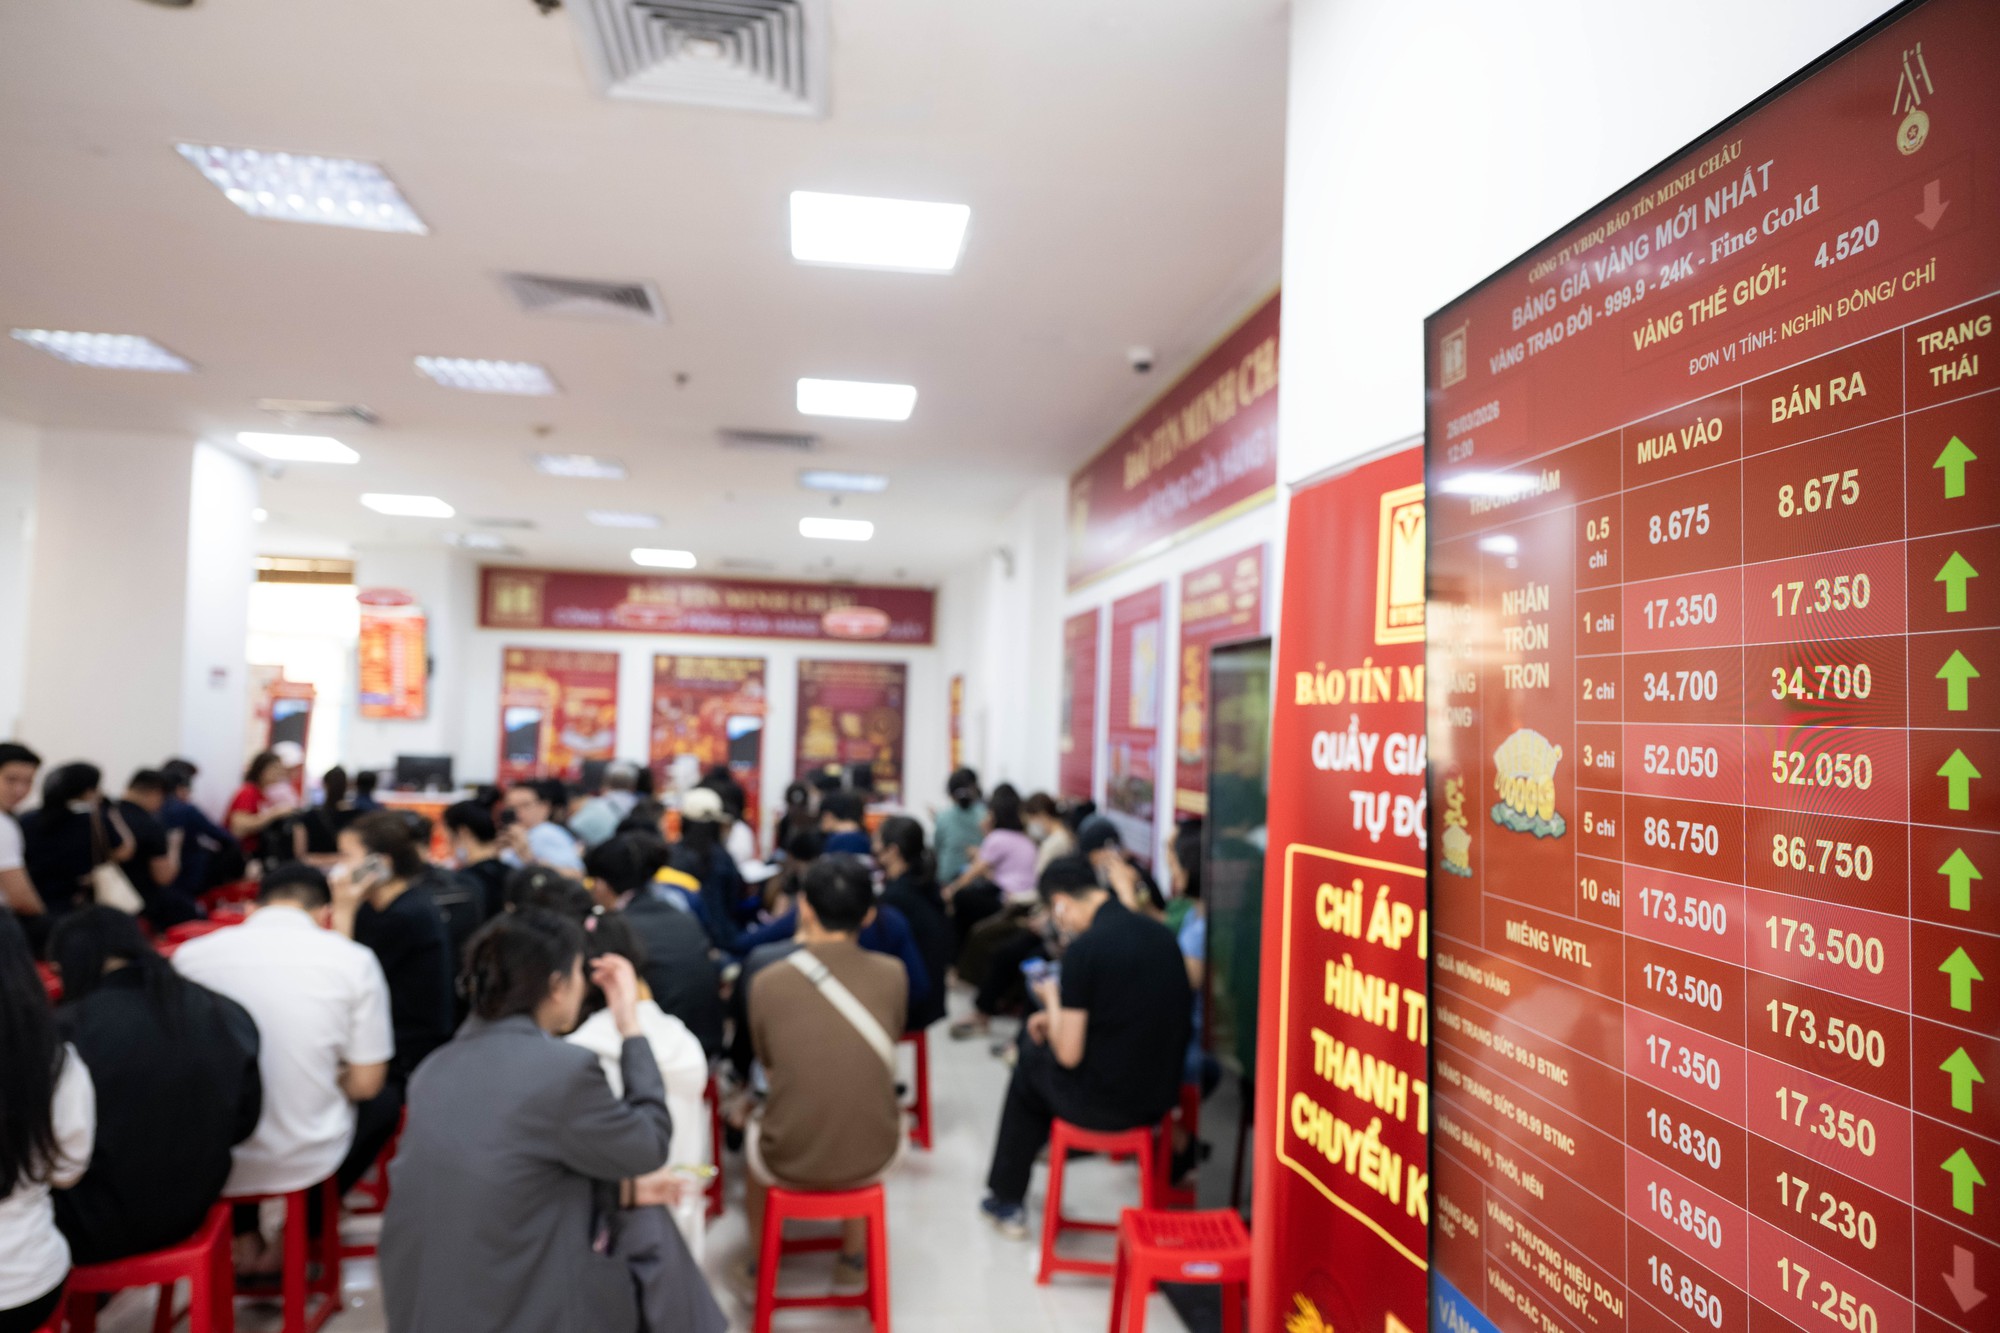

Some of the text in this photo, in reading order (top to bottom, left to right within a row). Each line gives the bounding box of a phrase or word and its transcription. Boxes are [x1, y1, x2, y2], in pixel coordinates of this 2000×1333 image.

[1528, 260, 1557, 284] CÔNG
[1558, 245, 1574, 267] TY
[1606, 208, 1631, 238] BẢO
[1631, 194, 1655, 220] TÍN
[1656, 168, 1697, 206] MINH
[1698, 139, 1743, 181] CHÂU
[1511, 158, 1775, 332] BẢNG GIÁ VÀNG MỚI NHẤT
[1489, 343, 1525, 376] VÀNG
[1526, 321, 1564, 357] TRAO
[1604, 278, 1646, 318] 999.9
[1659, 251, 1694, 291] 24K
[1709, 225, 1758, 265] Fine
[1762, 185, 1820, 236] Gold
[1632, 218, 1880, 352] VÀNG THẾ GIỚI: 4.520
[1688, 257, 1937, 376] ĐƠN VỊ TÍNH: NGHÌN ĐỒNG/ CHỈ
[1916, 314, 1993, 356] TRẠNG
[1770, 371, 1867, 424] BÁN RA
[1929, 353, 1979, 387] THÁI
[1637, 417, 1723, 465] MUA VÀO
[1586, 515, 1610, 542] 0.5
[1649, 468, 1861, 545] 8.675 8.675
[1582, 611, 1592, 634] 1
[1643, 573, 1872, 630] 17.350 17.350
[1502, 618, 1549, 653] TRÒN
[1295, 660, 1346, 706] BẢO
[1347, 656, 1393, 705] TÍN
[1502, 661, 1550, 690] TRƠN
[1583, 678, 1593, 700] 2
[1643, 663, 1872, 702] 34.700 34.700
[1583, 745, 1593, 767] 3
[1643, 744, 1873, 790] 52.050 52.050
[1349, 789, 1391, 843] TỰ
[1583, 812, 1594, 834] 5
[1643, 816, 1874, 882] 86.750 86.750
[1315, 877, 1364, 940] CHỈ
[1366, 884, 1414, 951] ÁP
[1579, 877, 1598, 902] 10
[1505, 919, 1592, 969] MIẾNG VRTL
[1638, 886, 1885, 975] 173.500 173.500
[1323, 952, 1399, 1032] HÌNH
[1483, 970, 1511, 998] VÀNG
[1642, 962, 1886, 1068] 173.500 173.500
[1310, 1026, 1407, 1123] THANH
[1461, 1017, 1492, 1047] TRANG
[1515, 1045, 1536, 1070] 99.9
[1537, 1056, 1569, 1087] BTMC
[1461, 1073, 1493, 1106] TRANG
[1515, 1106, 1542, 1136] 99.99
[1543, 1122, 1575, 1156] BTMC
[1645, 1033, 1877, 1157] 17.350 17.350
[1290, 1090, 1402, 1206] CHUYỂN
[1646, 1107, 1878, 1251] 16.830 17.230
[1486, 1199, 1624, 1320] VÀNG THƯƠNG HIỆU DOJI
[1510, 1240, 1531, 1271] PNJ
[1538, 1262, 1561, 1294] PHÚ
[1647, 1180, 1879, 1333] 16.850 17.250
[1487, 1266, 1516, 1304] VÀNG
[1516, 1293, 1539, 1324] CÁC
[1647, 1255, 1723, 1330] 16.850
